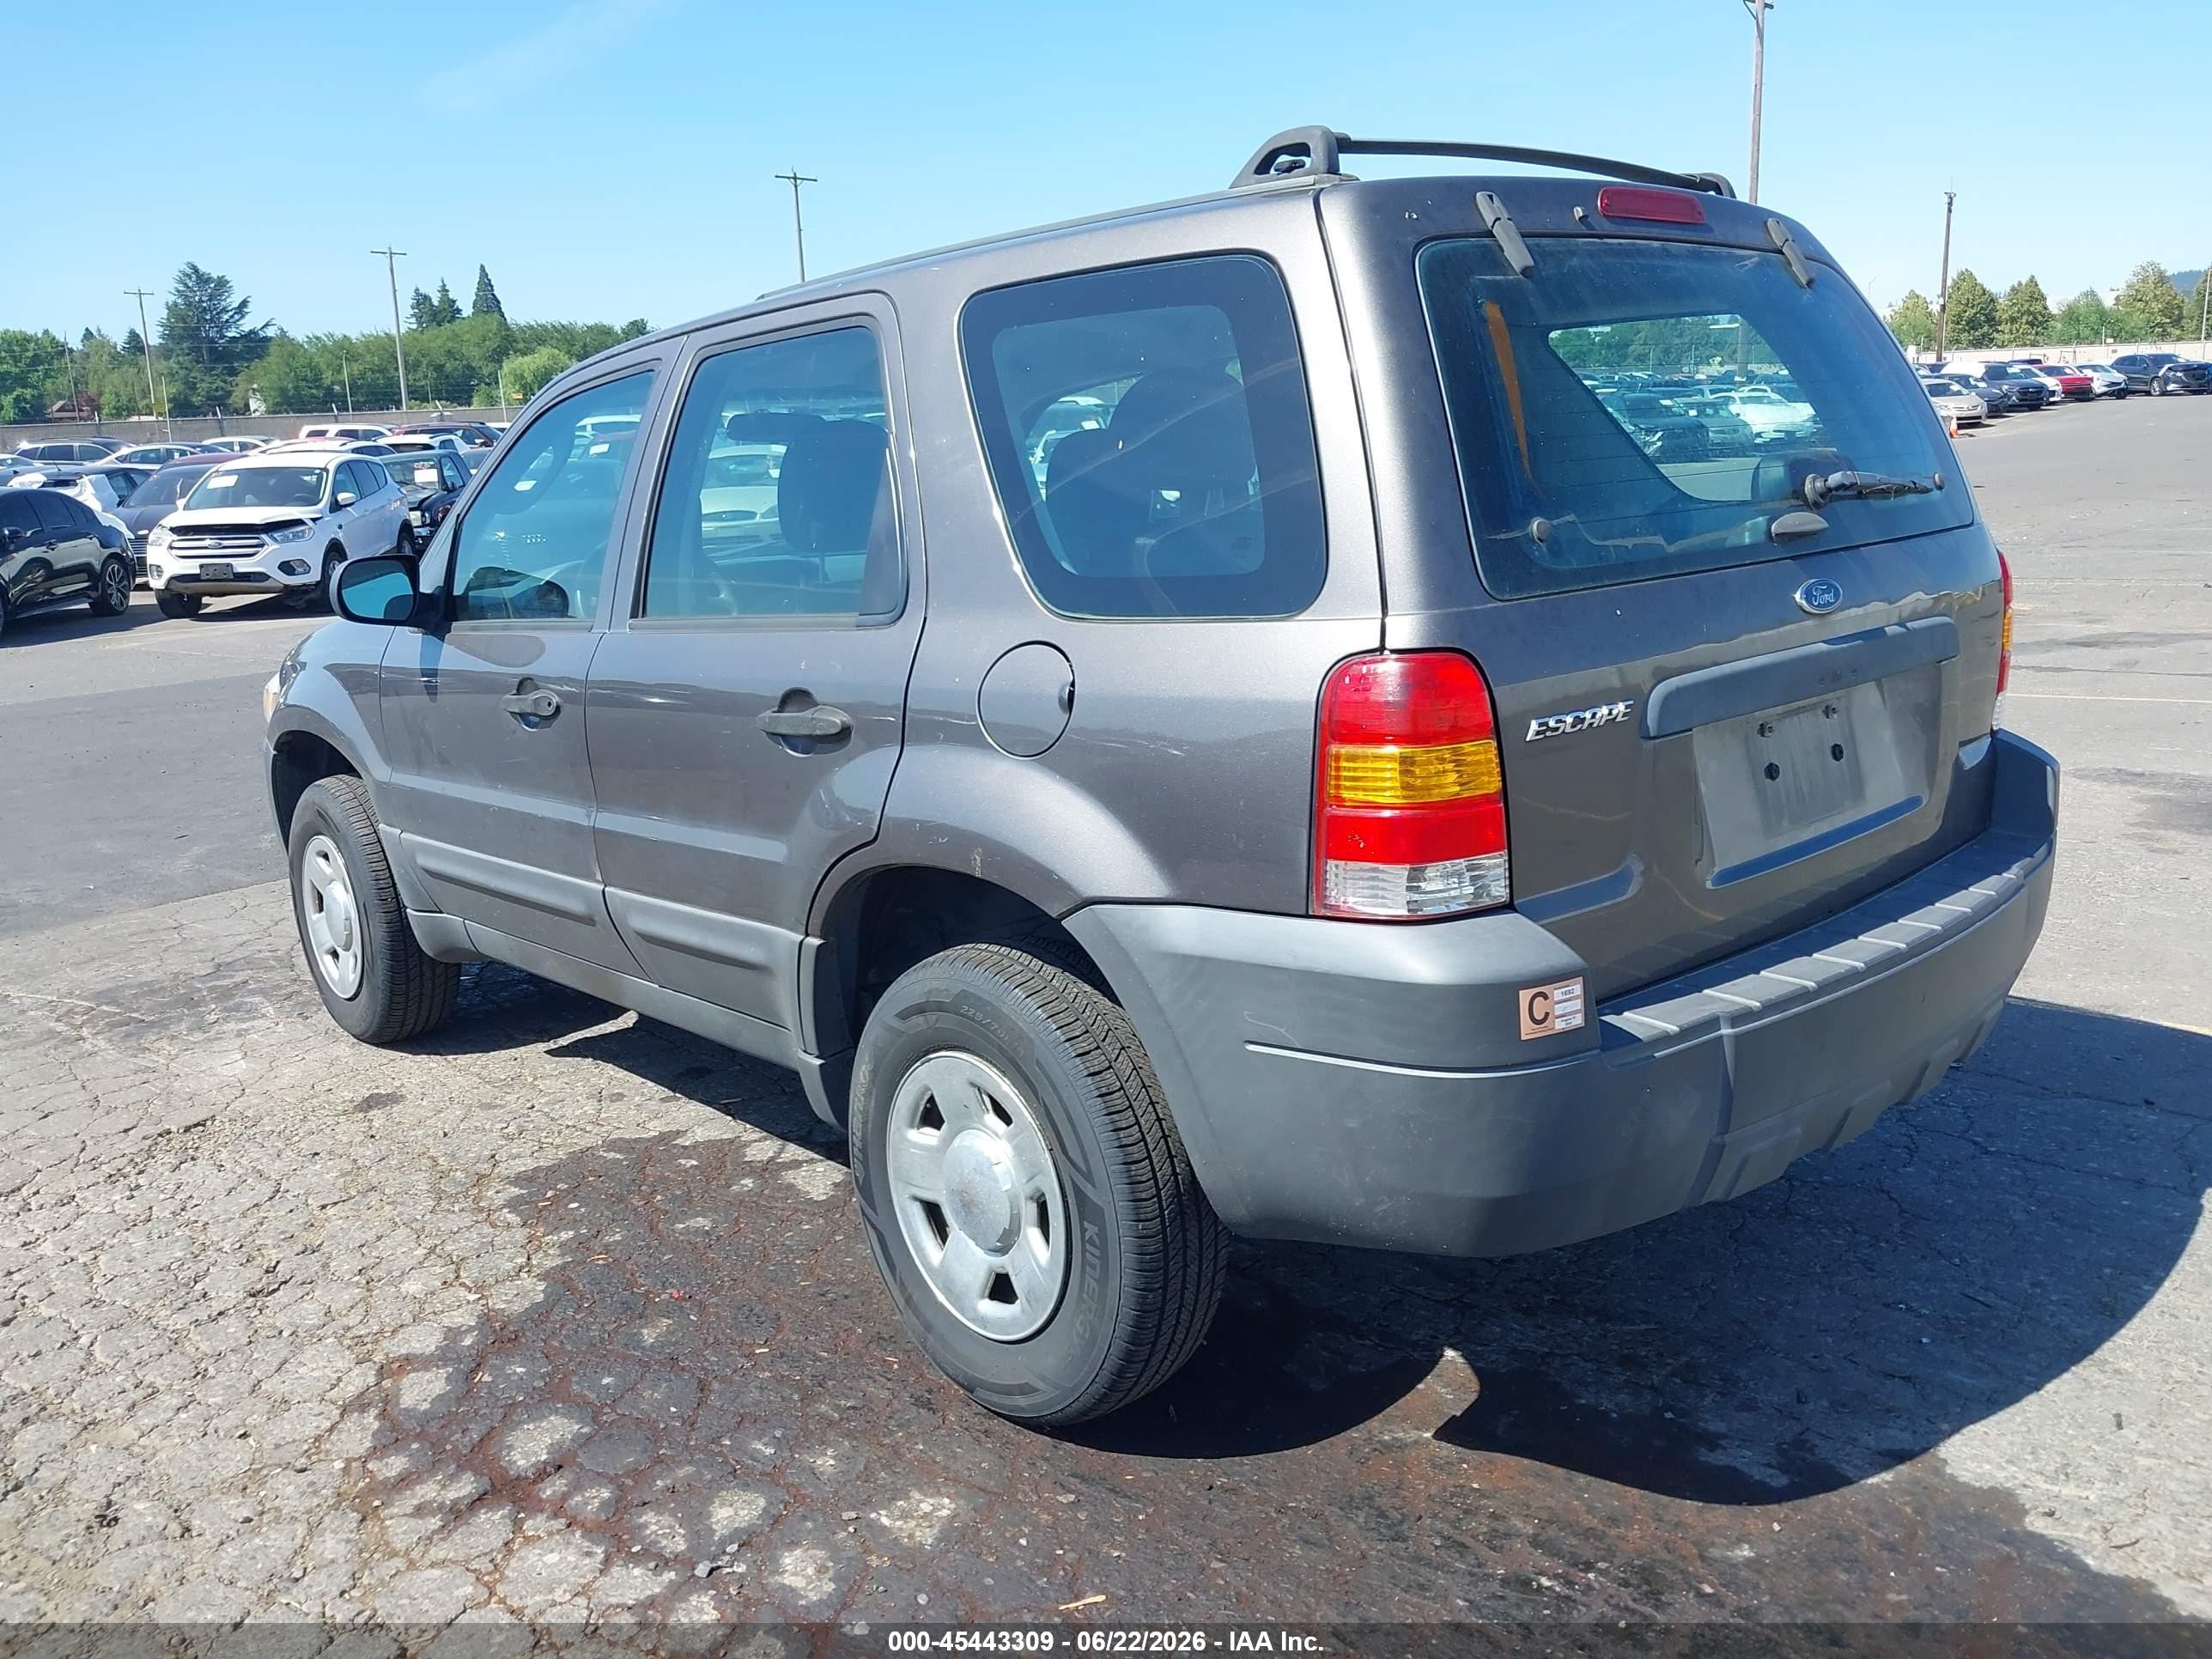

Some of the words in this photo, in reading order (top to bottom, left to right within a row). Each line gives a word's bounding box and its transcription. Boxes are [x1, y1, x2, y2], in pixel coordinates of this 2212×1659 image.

[1812, 585, 1836, 605] Ford
[1525, 700, 1635, 742] ESCAPE
[1528, 991, 1550, 1025] C
